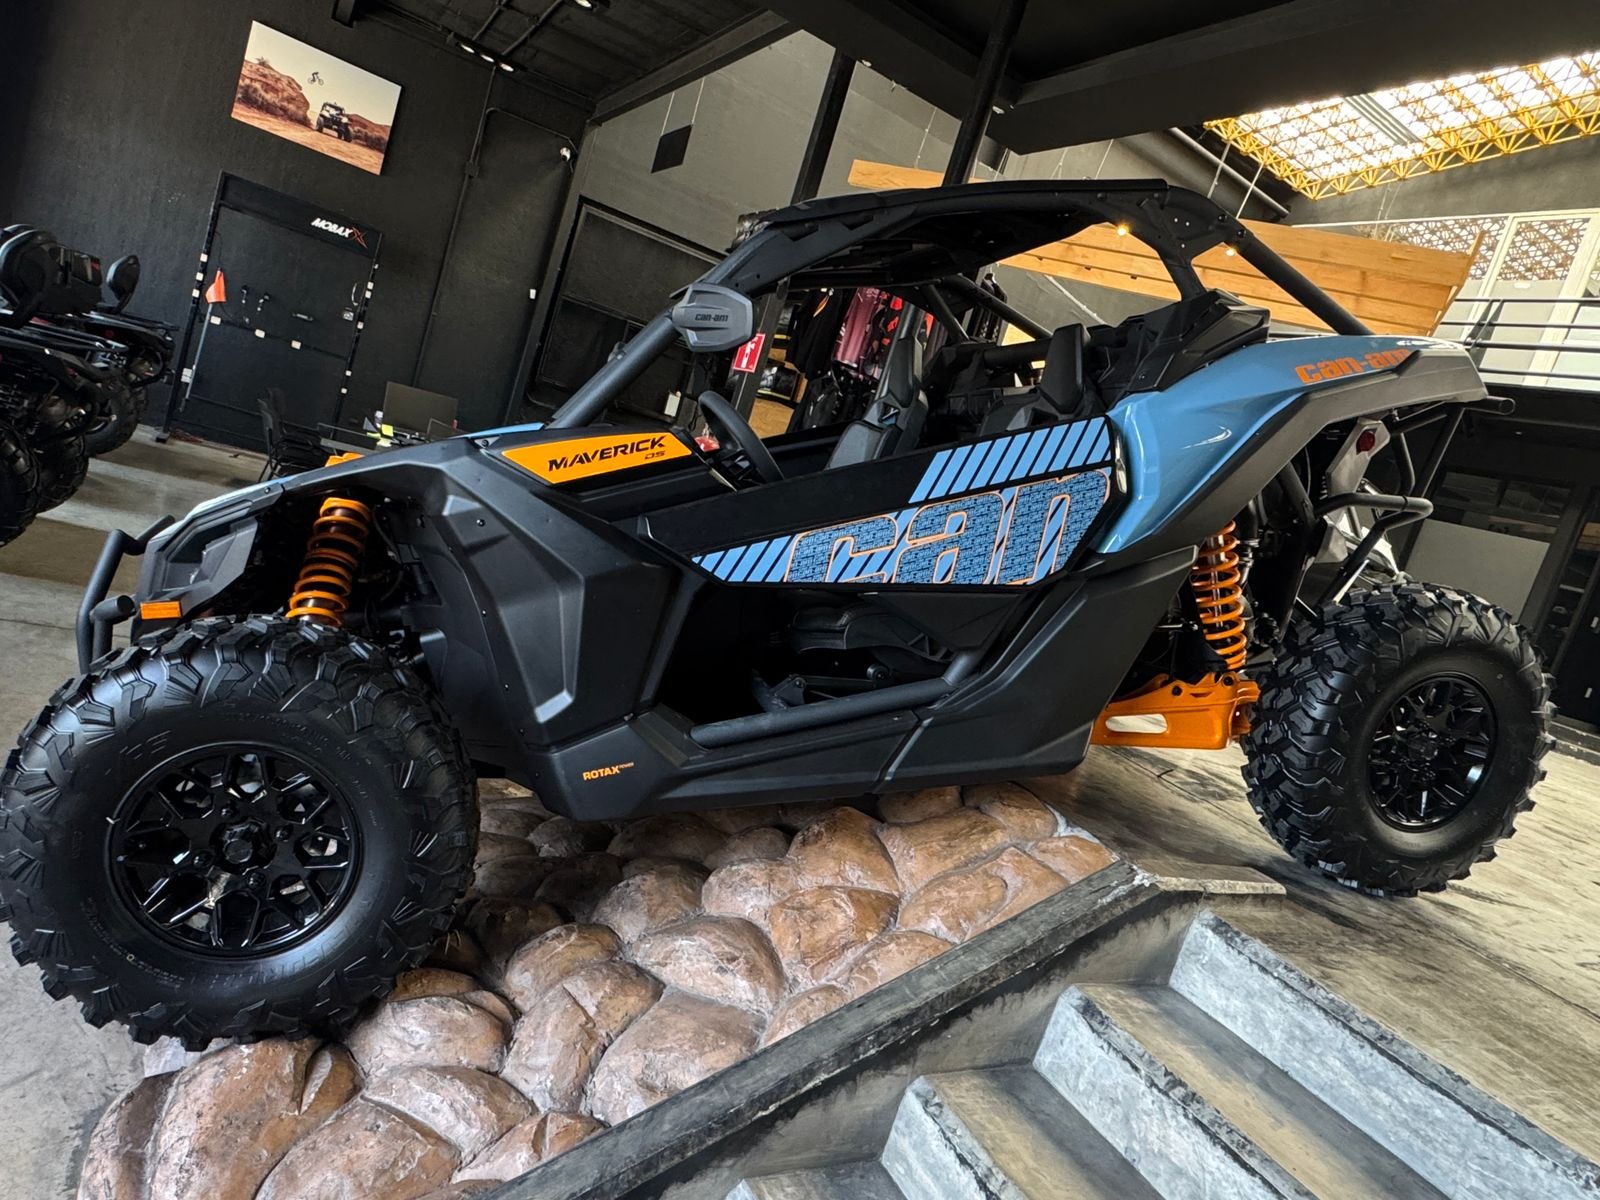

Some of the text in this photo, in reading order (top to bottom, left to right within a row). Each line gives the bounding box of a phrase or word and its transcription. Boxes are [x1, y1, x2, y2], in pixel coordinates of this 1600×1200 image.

[695, 314, 728, 322] can-am
[548, 436, 665, 471] MAVERICK
[645, 451, 665, 459] DS
[583, 765, 620, 780] ROTAX
